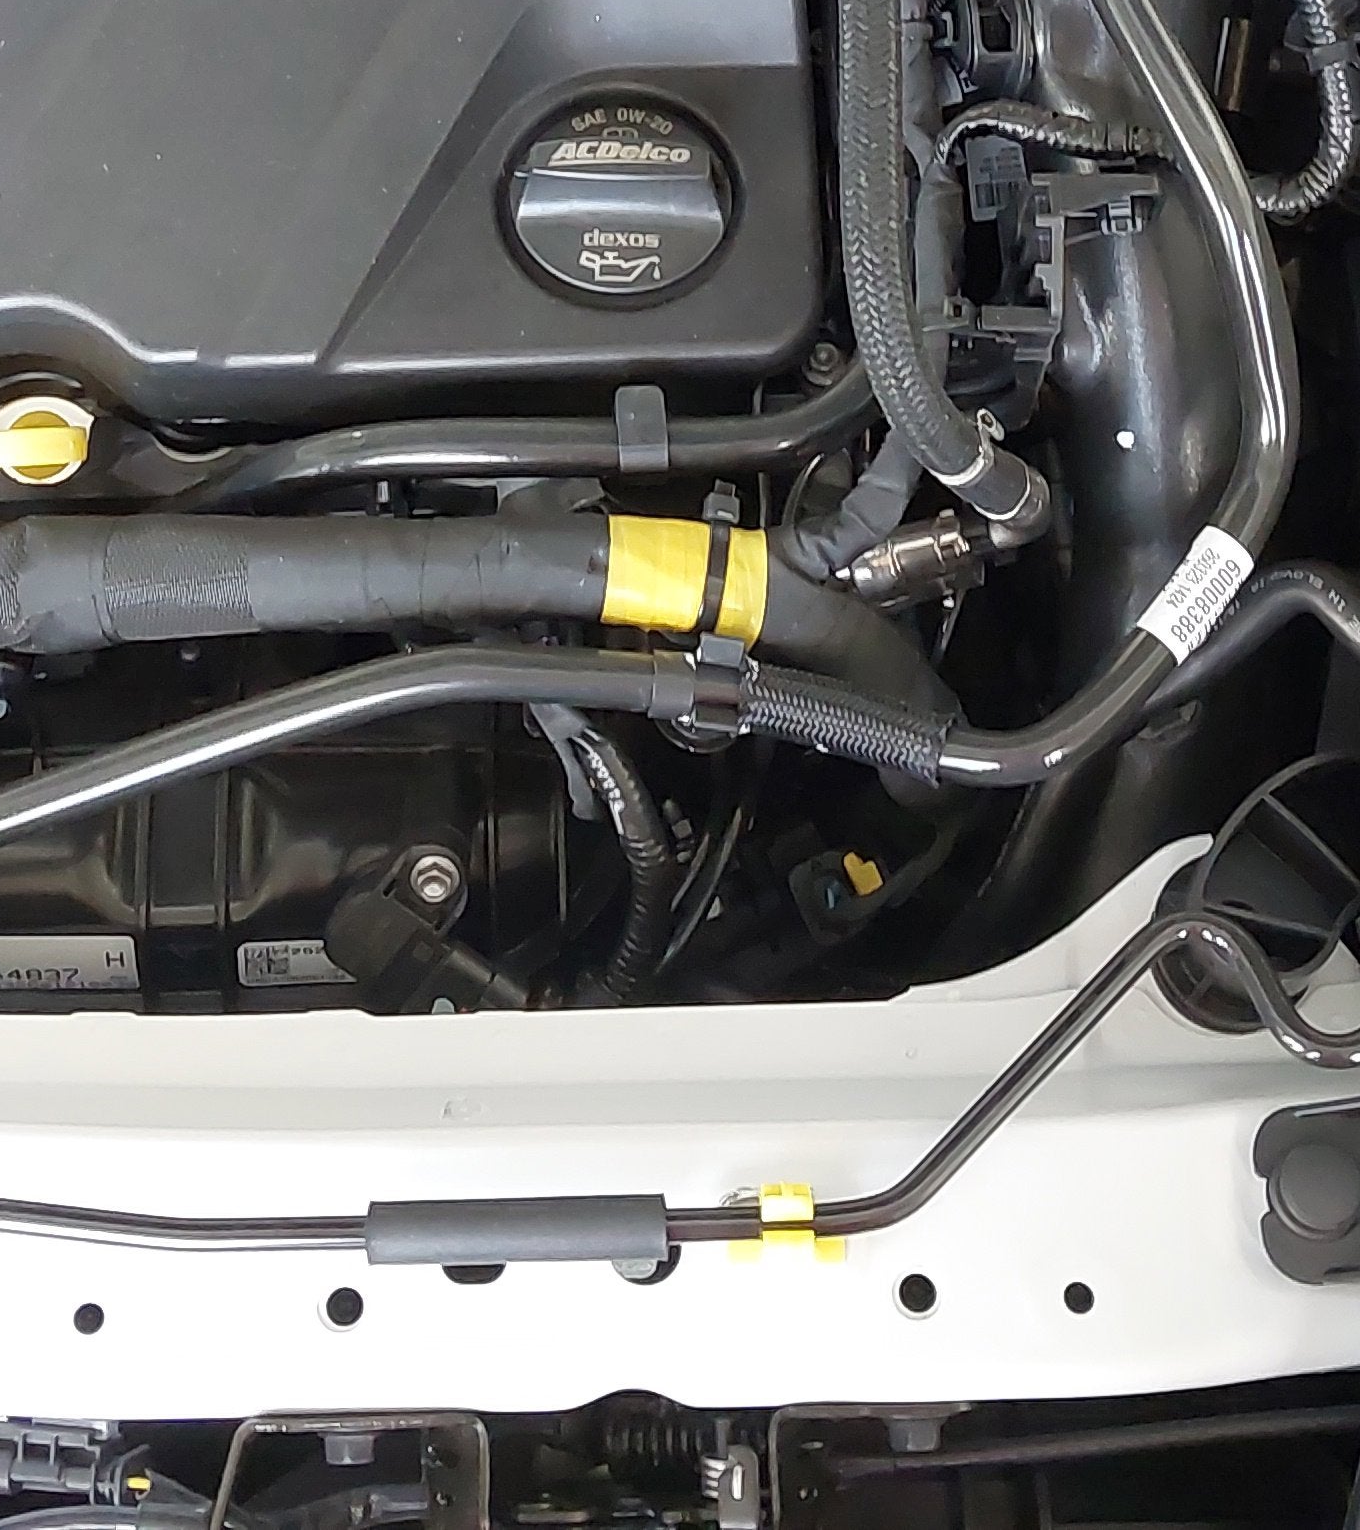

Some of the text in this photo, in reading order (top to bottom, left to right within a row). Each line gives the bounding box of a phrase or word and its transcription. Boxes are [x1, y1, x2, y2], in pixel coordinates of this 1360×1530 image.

[570, 107, 675, 136] SAE 0W-20
[548, 140, 692, 166] ACDelco
[582, 227, 661, 248] dexos
[1170, 559, 1241, 643] 60008388
[105, 950, 125, 968] H
